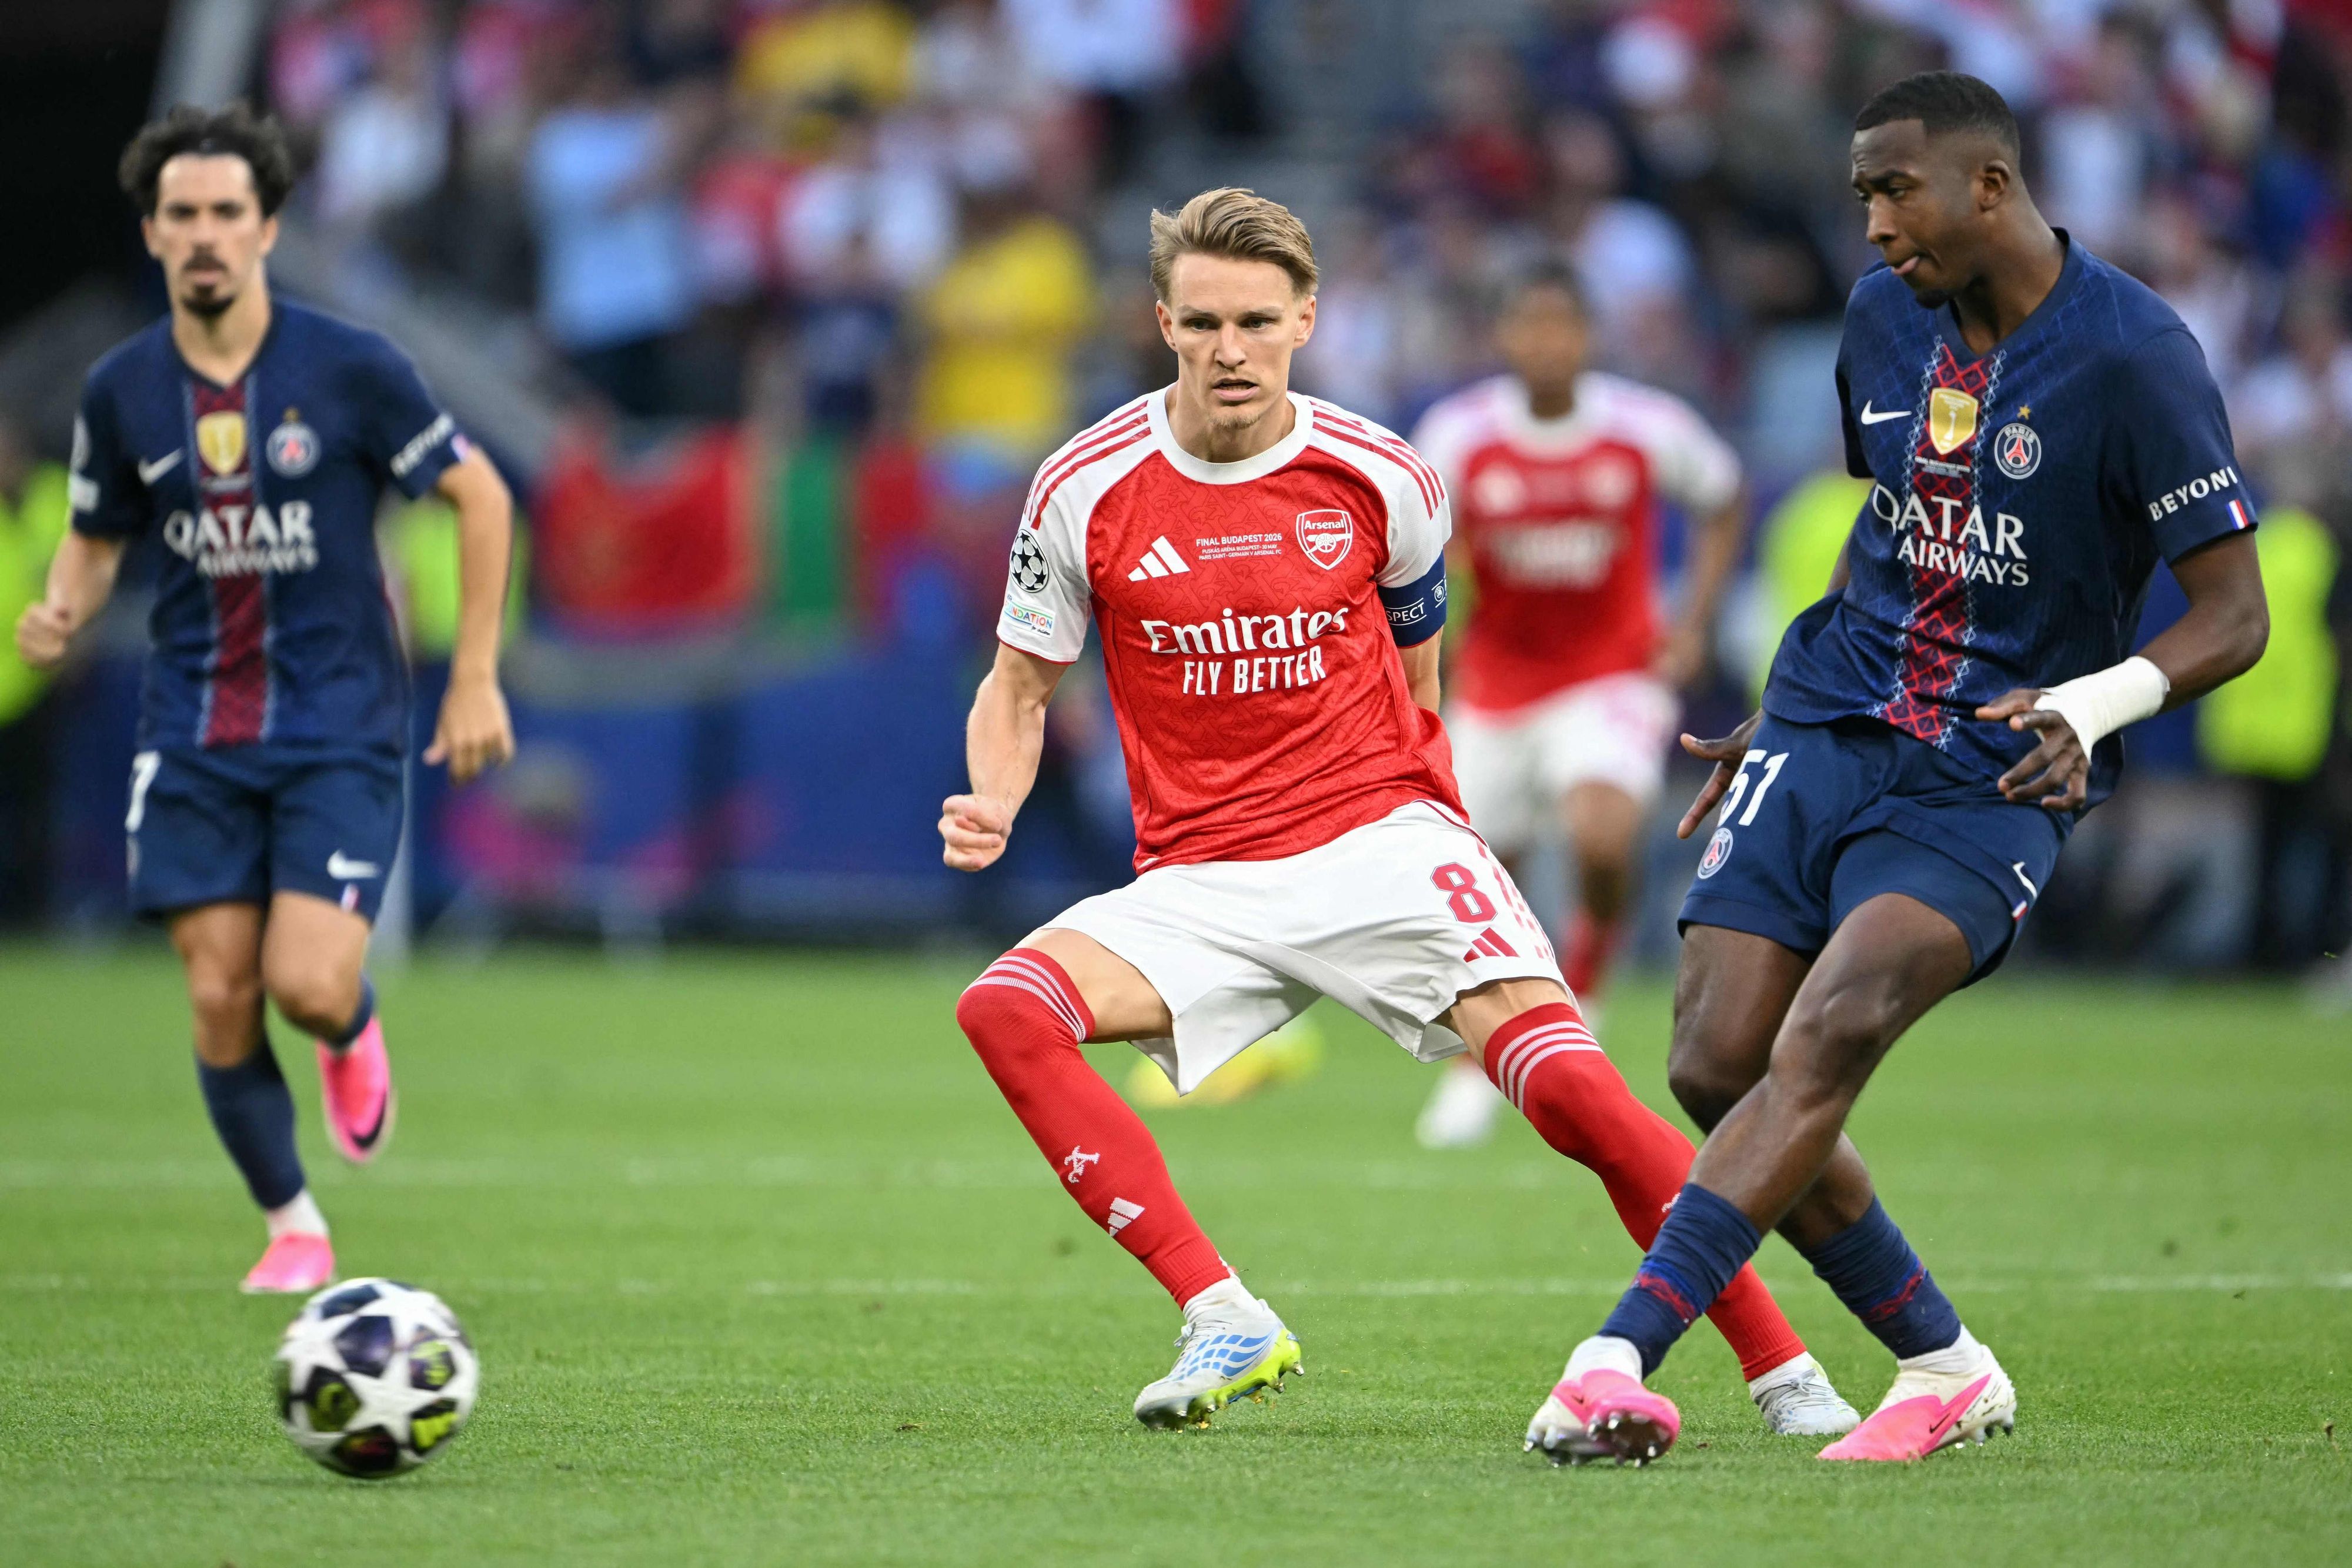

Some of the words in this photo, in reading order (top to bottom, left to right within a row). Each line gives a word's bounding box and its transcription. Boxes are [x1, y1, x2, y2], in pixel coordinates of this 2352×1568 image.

[163, 500, 315, 563] QATAR
[1196, 538, 1220, 547] FINAL
[1221, 534, 1262, 544] BUDAPEST
[1264, 533, 1282, 541] 2026
[1304, 519, 1345, 529] Arsenal
[1872, 483, 2028, 560] QATAR
[1897, 536, 2029, 586] AIRWAYS
[1141, 606, 1348, 654] Emirates
[1386, 602, 1424, 621] SPECT
[1182, 661, 1222, 696] FLY
[1233, 645, 1326, 694] BETTER
[1717, 749, 1789, 827] 51
[1430, 862, 1498, 923] 8
